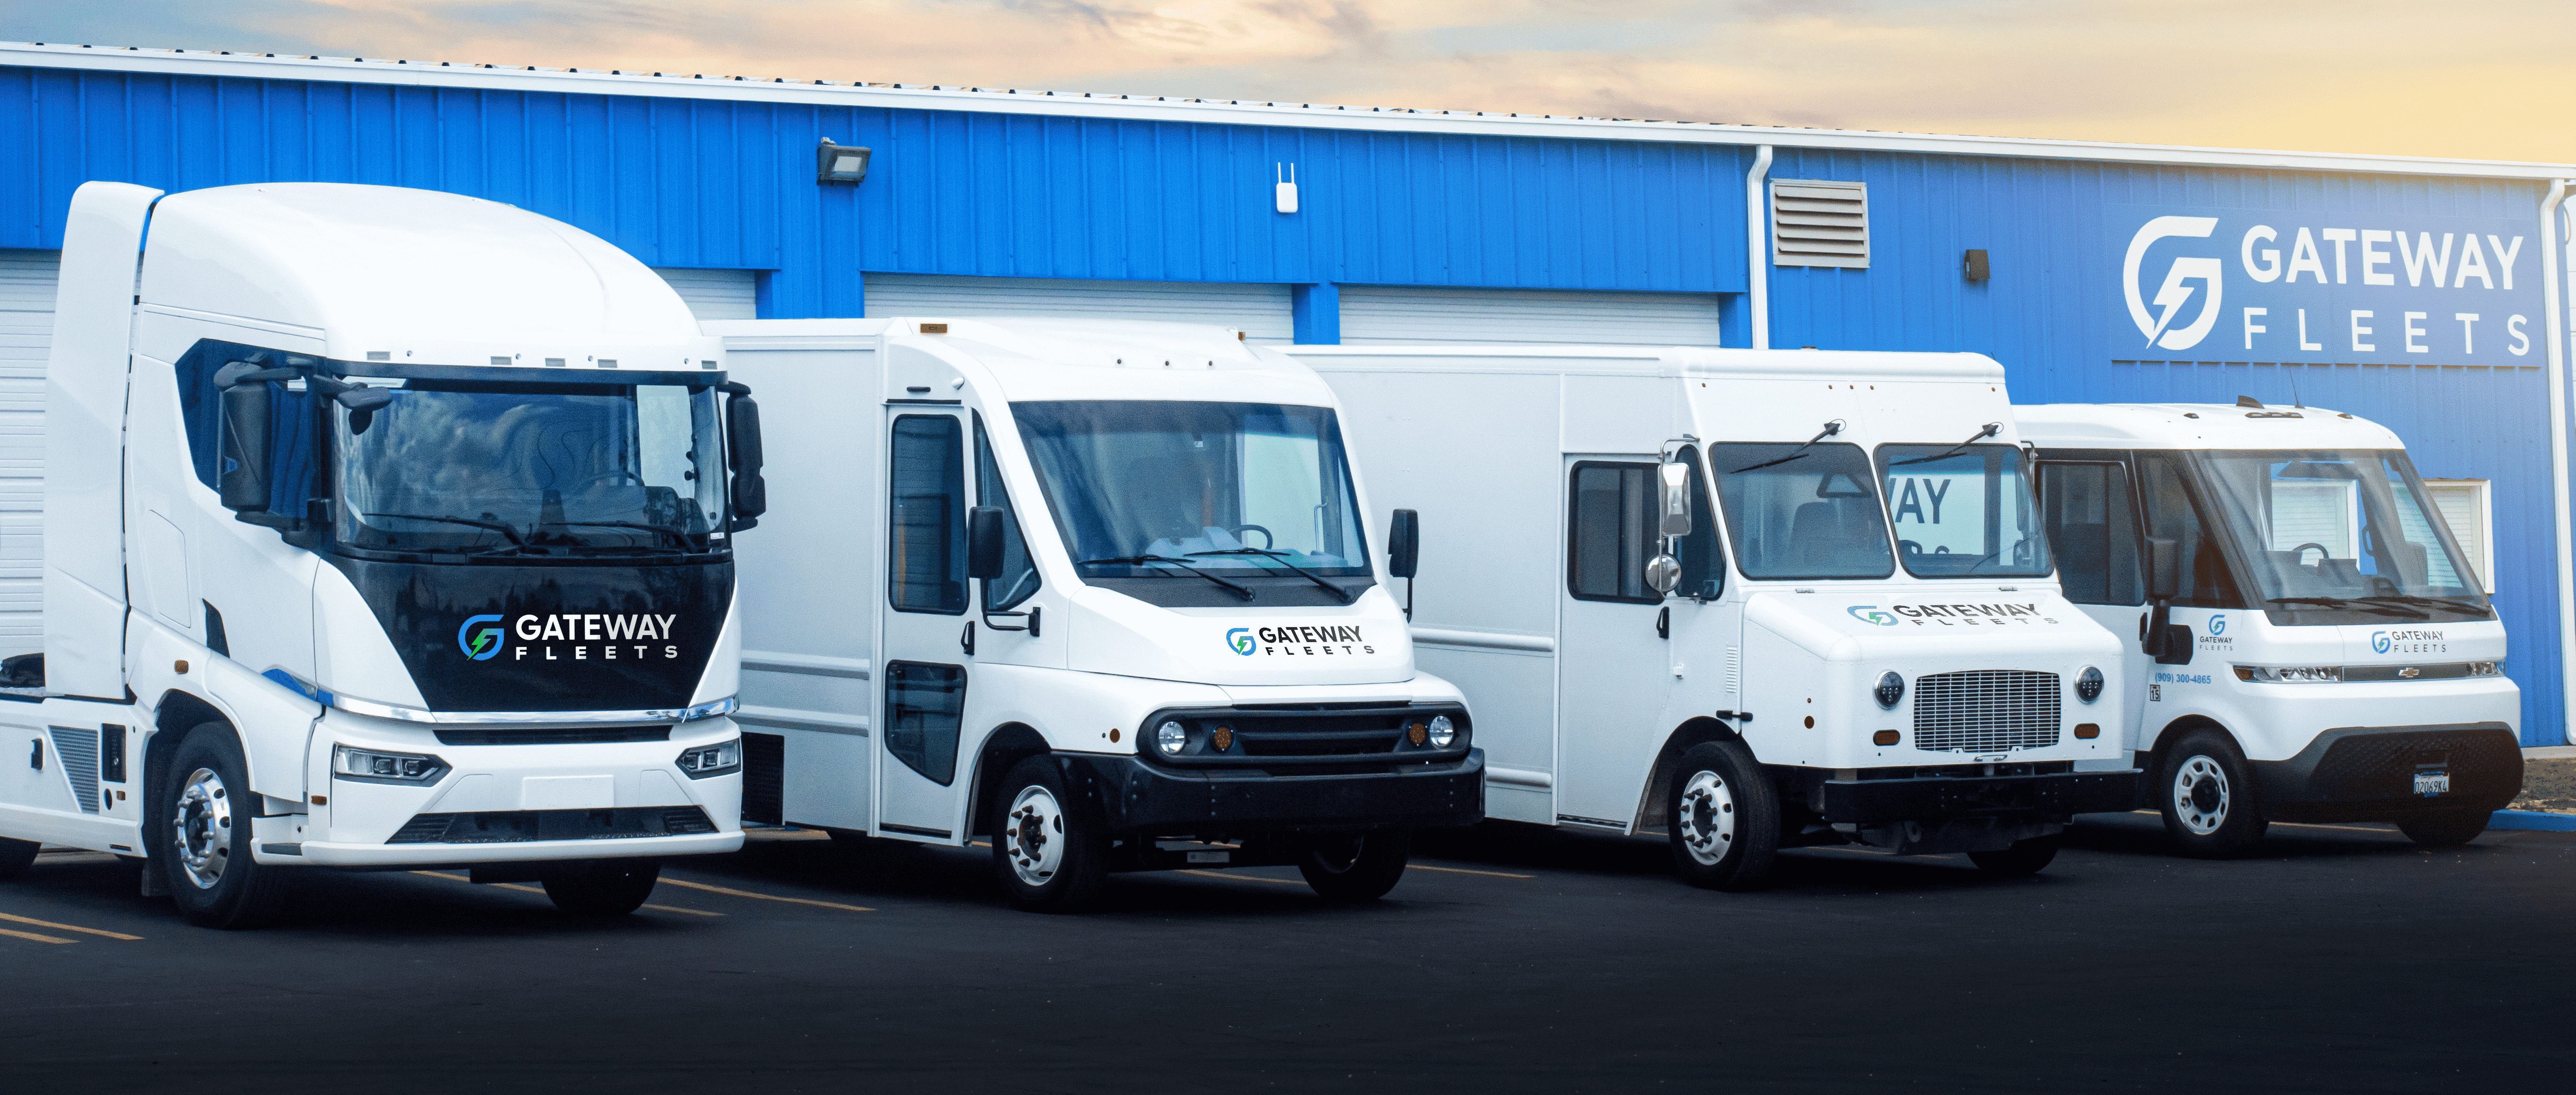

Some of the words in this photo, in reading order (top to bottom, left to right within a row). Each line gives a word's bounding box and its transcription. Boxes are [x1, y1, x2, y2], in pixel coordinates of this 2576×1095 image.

[2241, 225, 2524, 290] GATEWAY
[2244, 307, 2530, 356] FLEETS
[1889, 477, 1951, 524] AY
[1892, 604, 2041, 617] GATEWAY
[516, 614, 676, 641] GATEWAY
[1911, 618, 2059, 626] FLEETS
[1259, 626, 1363, 643] GATEWAY
[2391, 630, 2443, 640] GATEWAY
[516, 645, 678, 660] FLEETS
[1265, 645, 1375, 656] FLEETS
[2394, 644, 2446, 653] FLEETS
[2155, 672, 2174, 684] (909)
[2176, 674, 2211, 684] 300-4865
[2151, 689, 2159, 700] 15
